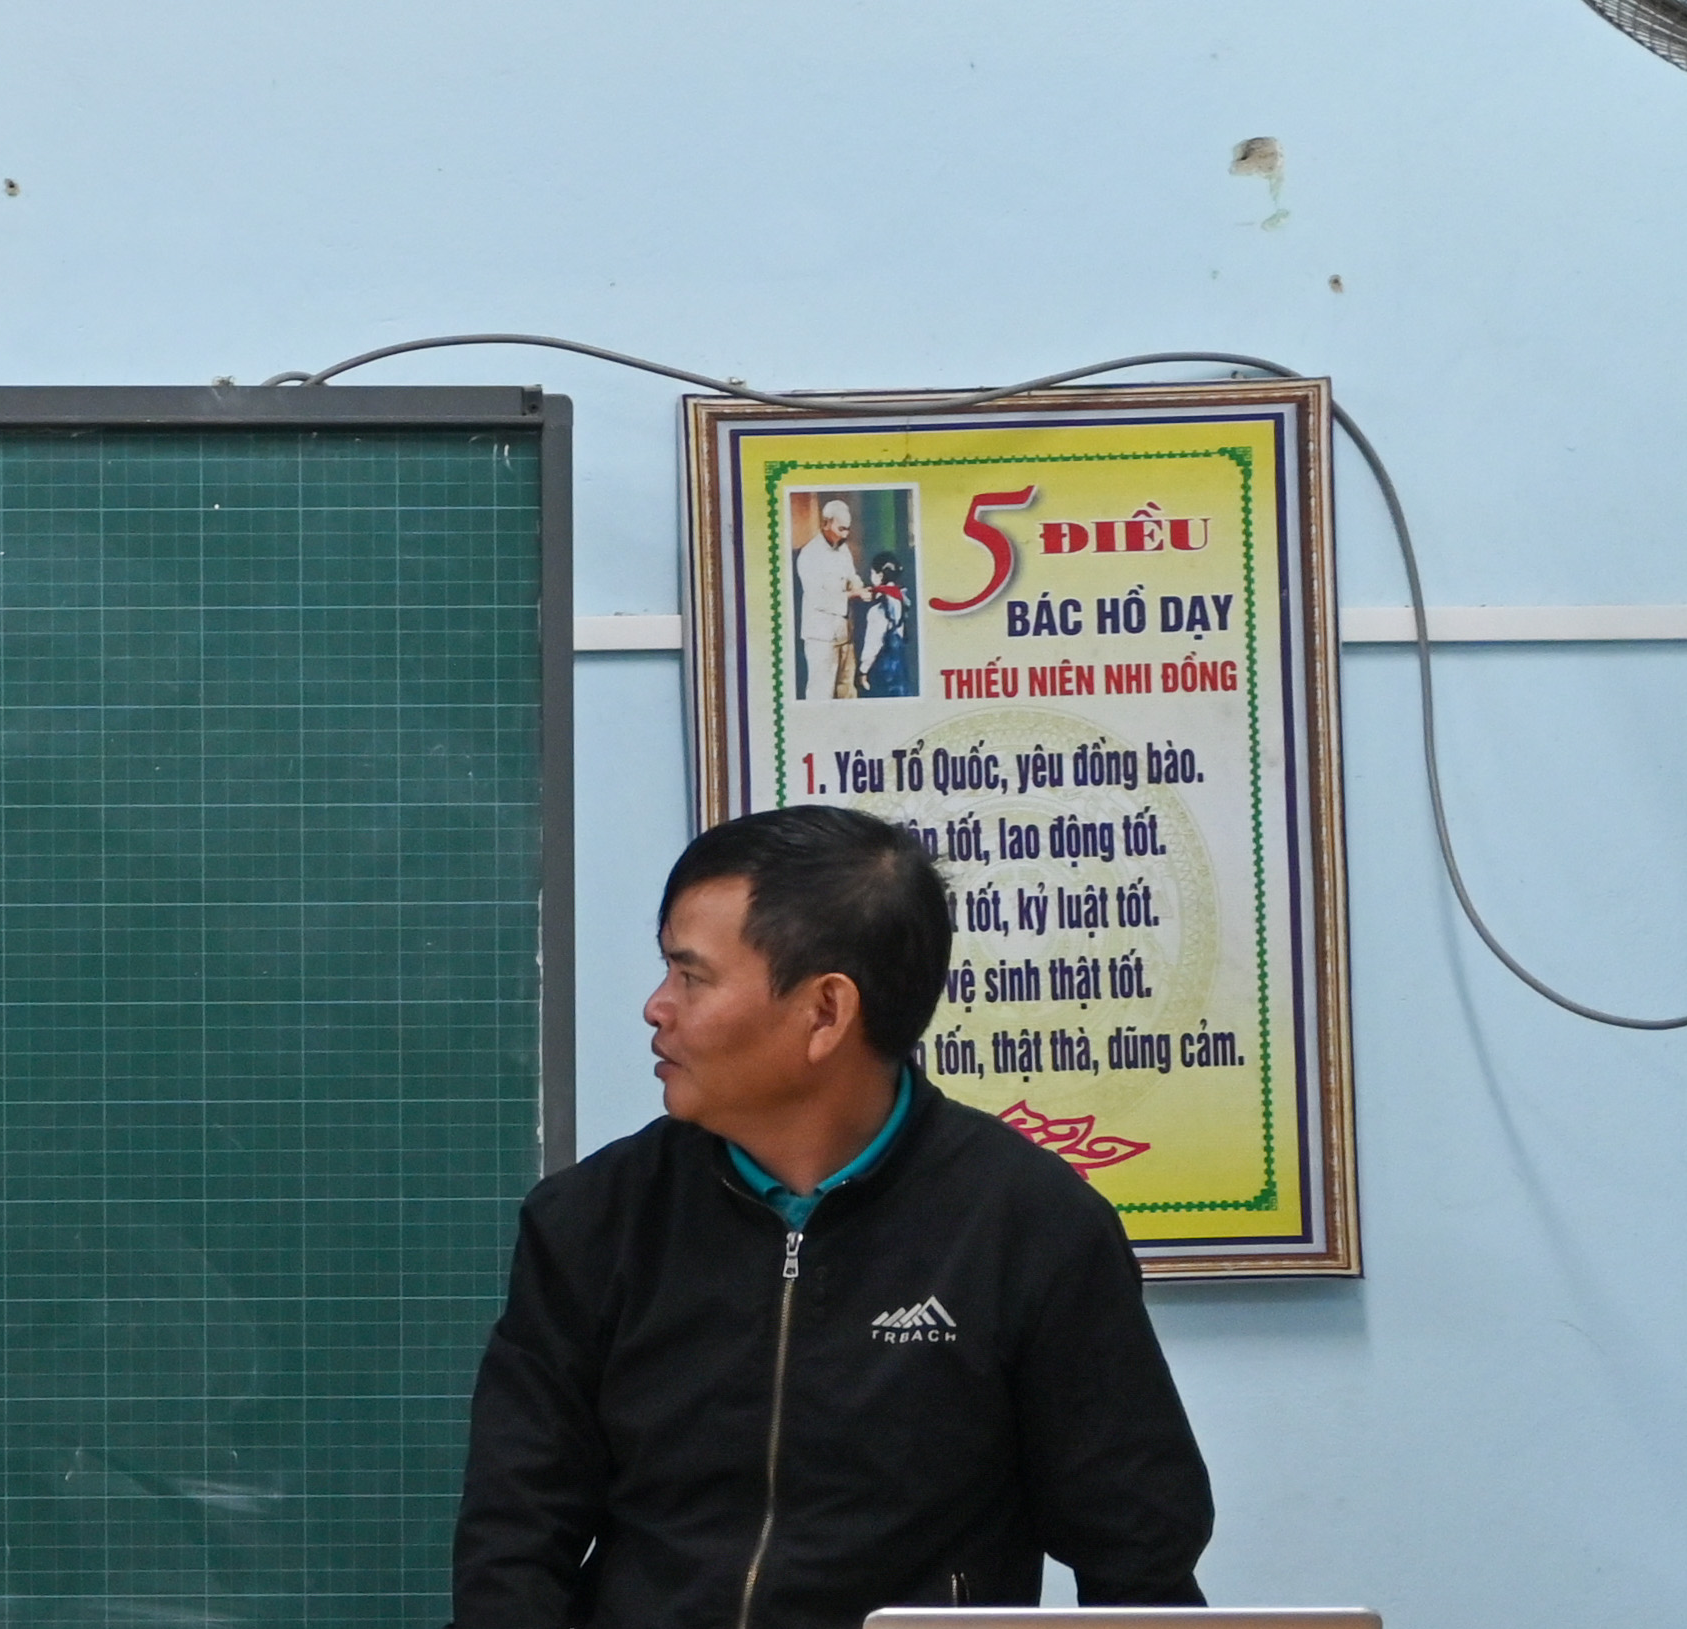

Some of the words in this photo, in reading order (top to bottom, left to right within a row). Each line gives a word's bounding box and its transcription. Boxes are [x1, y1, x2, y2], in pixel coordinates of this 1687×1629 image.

[928, 485, 1036, 612] 5
[1039, 502, 1212, 555] ĐIỀU
[1006, 590, 1083, 638] BÁC
[1096, 583, 1148, 635] HỒ
[1160, 595, 1232, 641] DẠY
[940, 655, 1019, 700] THIẾU
[1027, 658, 1094, 698] NIÊN
[1103, 664, 1152, 695] NHI
[1160, 652, 1238, 694] ĐỒNG
[802, 752, 826, 795] 1.
[835, 749, 884, 793] Yêu
[891, 738, 924, 791] Tổ
[932, 740, 1007, 793] Quốc,
[1016, 748, 1064, 791] yêu
[1072, 738, 1137, 791] đồng
[1147, 744, 1204, 785] bào.
[947, 811, 990, 866] tốt,
[999, 818, 1040, 859] lao
[1049, 813, 1115, 868] động
[1123, 806, 1166, 856] tốt.
[966, 882, 1009, 937] tốt,
[1018, 882, 1048, 936] kỷ
[1058, 885, 1109, 938] luật
[1117, 877, 1159, 927] tốt.
[946, 960, 976, 1013] vệ
[985, 959, 1040, 1003] sinh
[1049, 956, 1101, 1009] thật
[1109, 948, 1152, 998] tốt.
[935, 1025, 984, 1079] tốn,
[993, 1029, 1043, 1082] thật
[1051, 1028, 1099, 1076] thà,
[1108, 1027, 1171, 1073] dũng
[1181, 1019, 1245, 1067] cảm.
